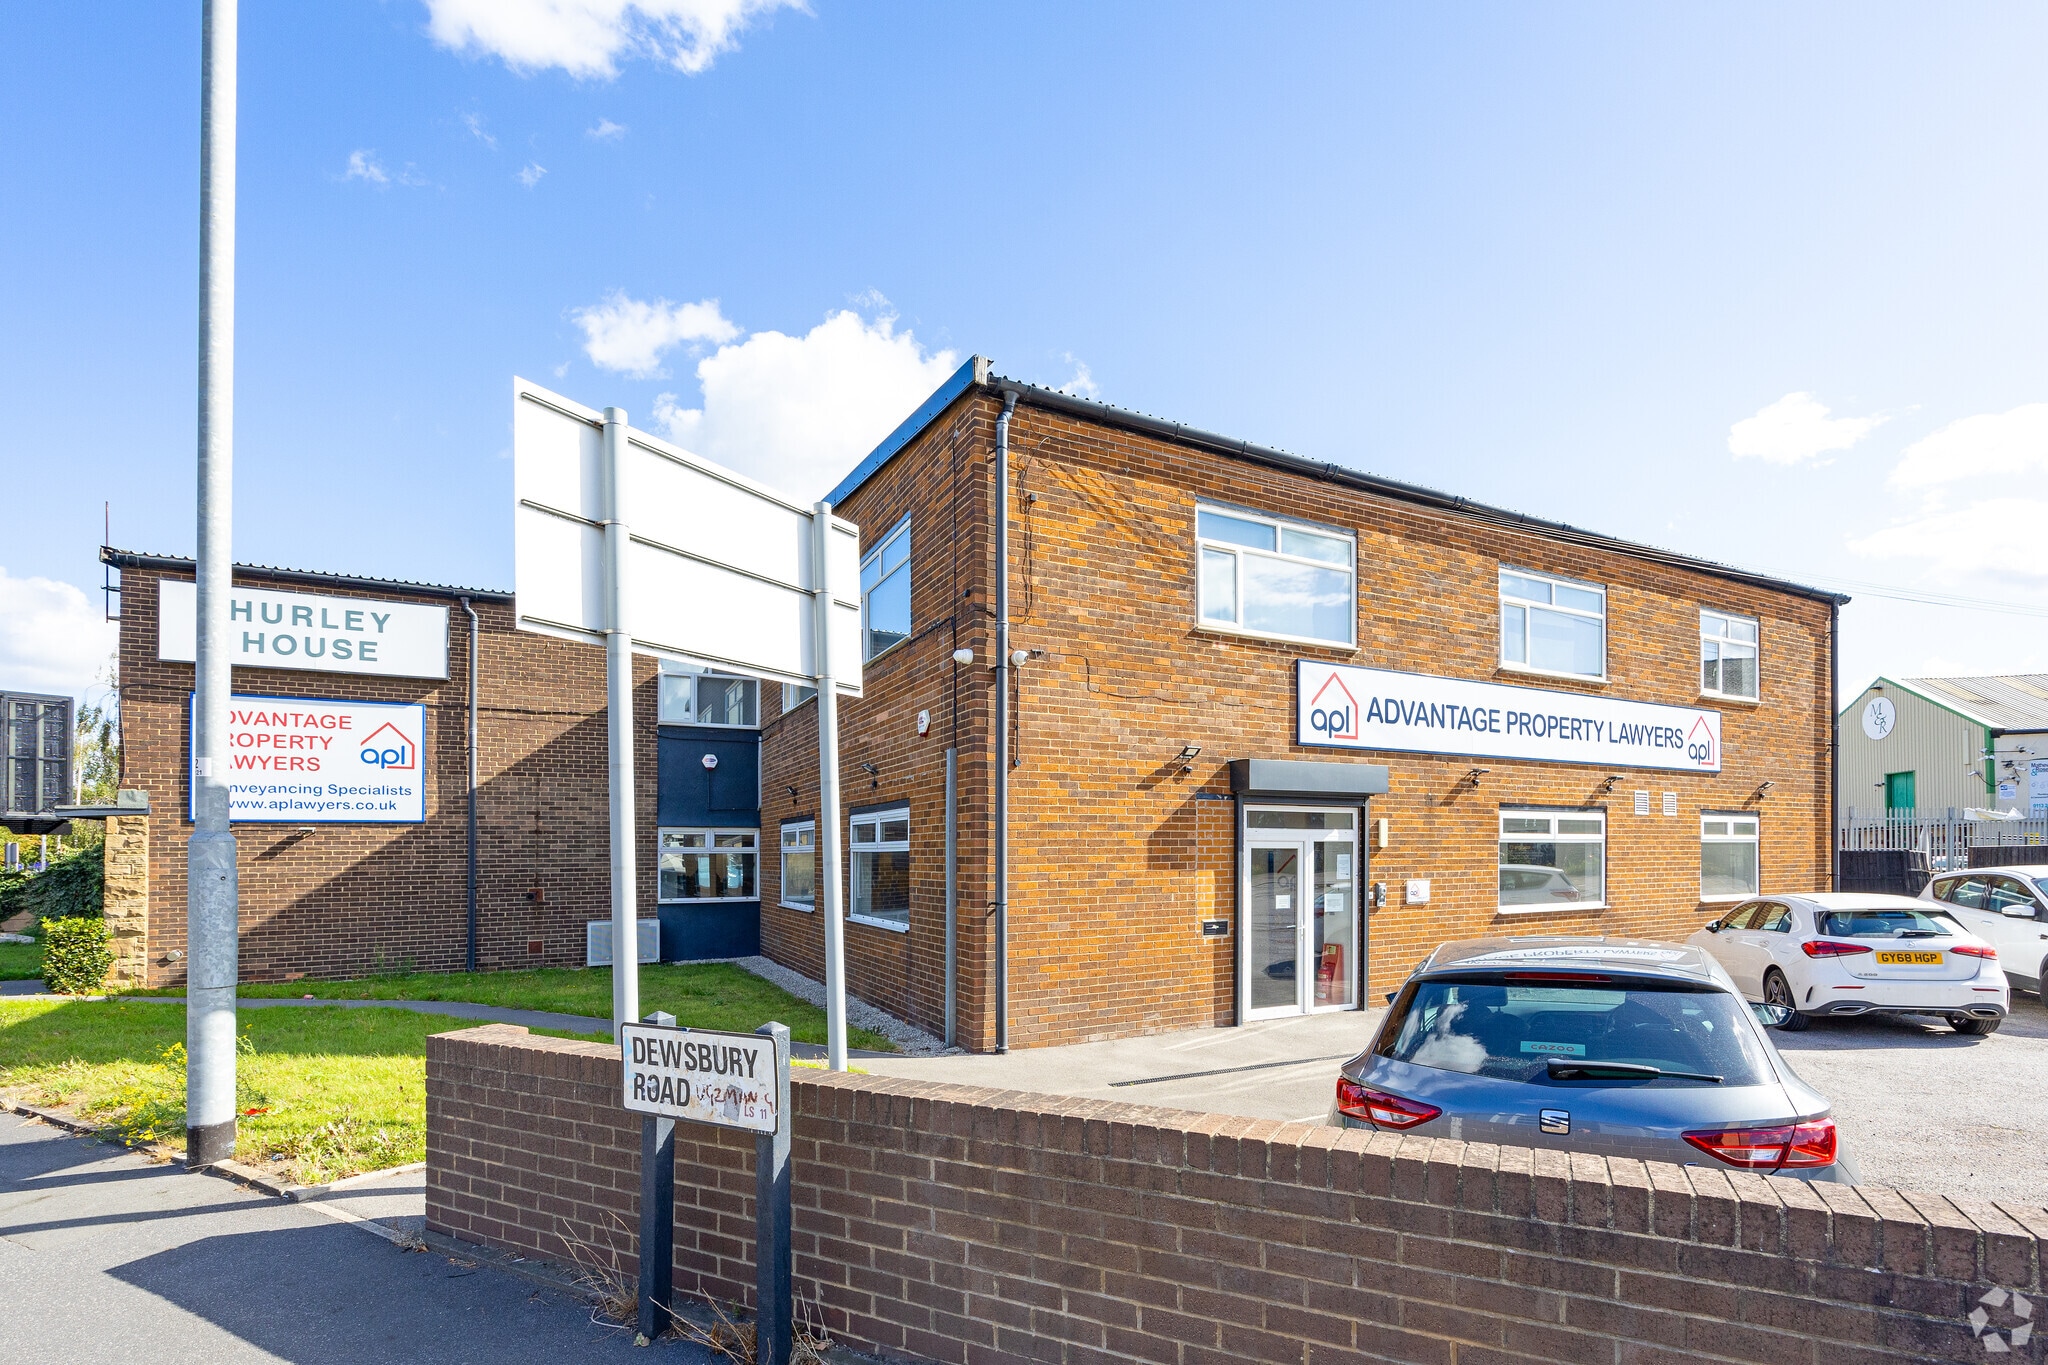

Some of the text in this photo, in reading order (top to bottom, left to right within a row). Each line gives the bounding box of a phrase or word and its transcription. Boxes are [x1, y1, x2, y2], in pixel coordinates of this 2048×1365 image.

[231, 600, 391, 633] HURLEY
[243, 631, 378, 662] HOUSE
[230, 710, 352, 730] VANTAGE
[230, 732, 333, 750] OPERTY
[1311, 697, 1710, 765] apl ADVANTAGE PROPERTY LAWYERS apl
[230, 754, 321, 771] WYERS
[360, 745, 406, 769] apl
[229, 783, 412, 797] nveyancing Specialists
[1881, 953, 1938, 963] GY68 HGP
[632, 1036, 758, 1079] DEWSBURY
[1530, 1043, 1575, 1052] CAZOO
[633, 1072, 690, 1107] ROAD
[744, 1105, 767, 1120] LS 11
